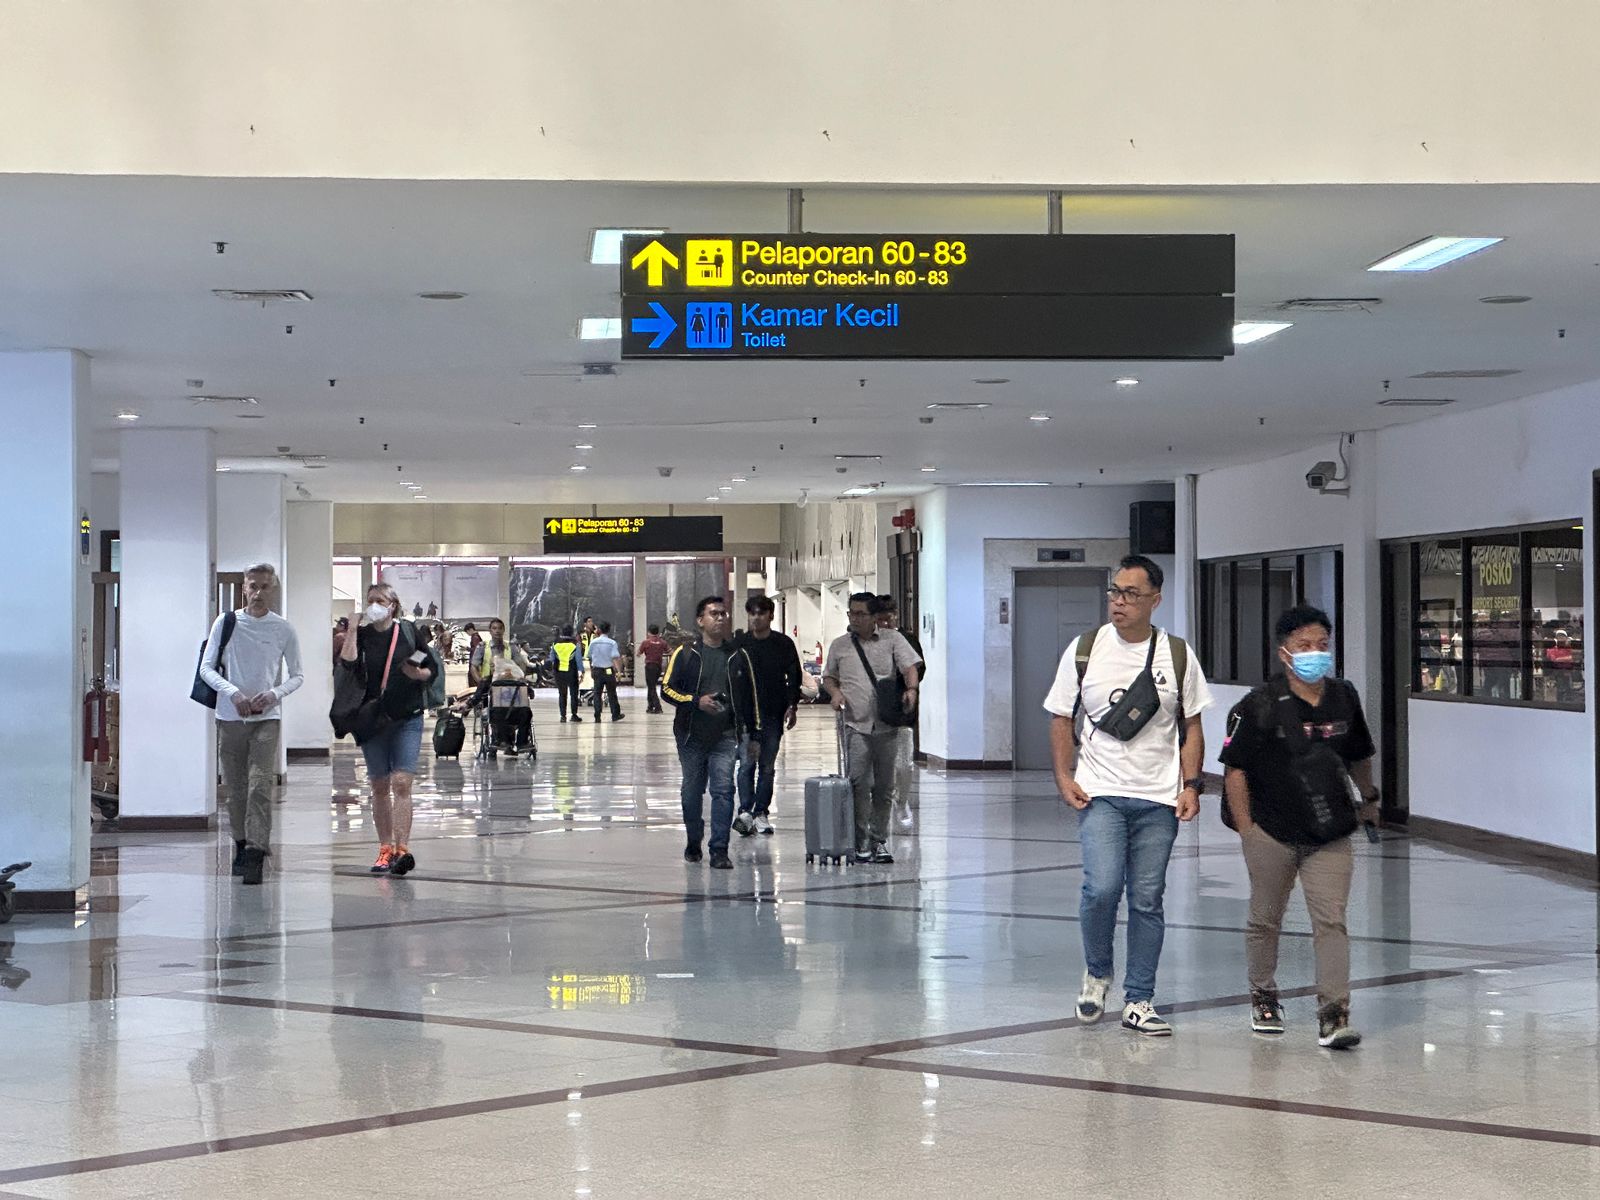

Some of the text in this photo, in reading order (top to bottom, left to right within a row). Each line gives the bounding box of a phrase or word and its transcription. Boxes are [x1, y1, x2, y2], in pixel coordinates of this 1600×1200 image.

[741, 240, 874, 269] Pelaporan
[741, 269, 810, 285] Counter
[813, 269, 890, 285] Check-In
[741, 303, 899, 327] Kamar Kecil
[741, 332, 787, 347] Toilet
[578, 518, 617, 528] Pelaporan
[1479, 561, 1512, 586] POSKO
